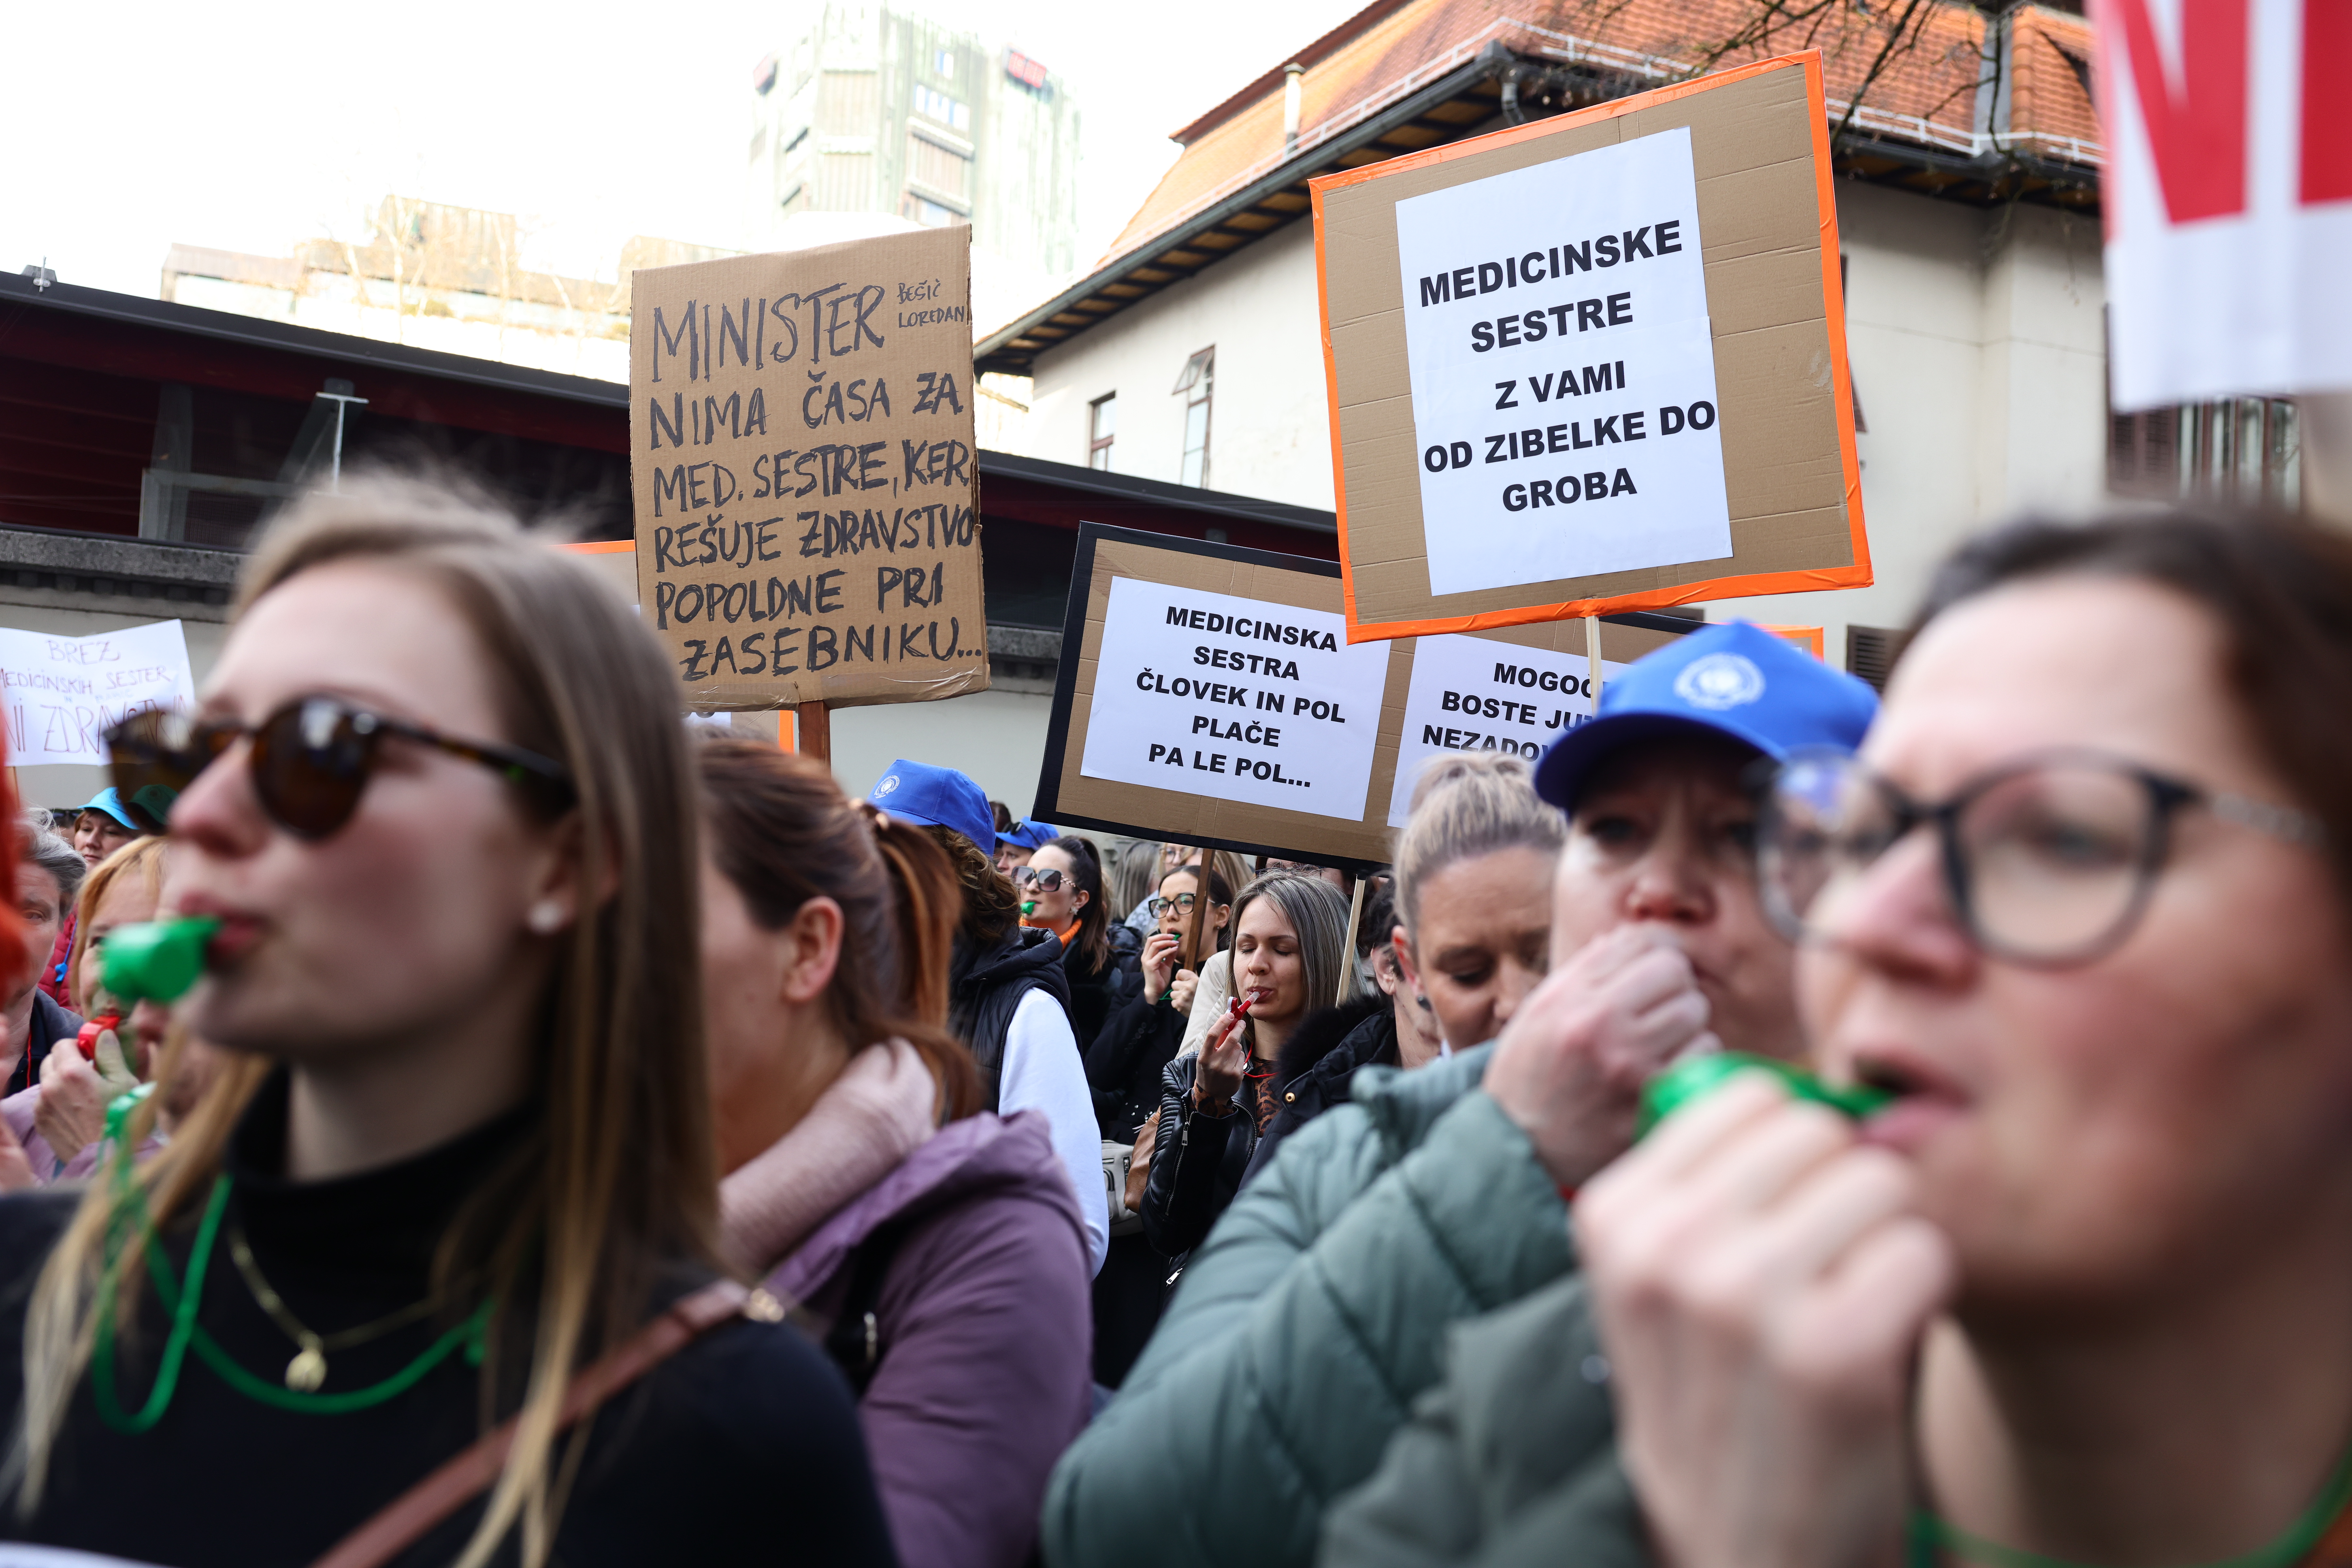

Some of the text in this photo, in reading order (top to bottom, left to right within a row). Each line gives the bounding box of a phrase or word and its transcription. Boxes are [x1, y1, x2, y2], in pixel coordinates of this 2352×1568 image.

[1420, 220, 1682, 307] MEDICINSKE
[652, 282, 885, 384] MINISTER
[899, 305, 965, 329] LOREDAN
[1471, 291, 1633, 353] SESTRE
[1495, 360, 1626, 410] Z VAMI
[650, 387, 771, 451] NIMA
[802, 370, 891, 429] ČASA
[1424, 401, 1715, 473] OD ZIBELKE DO
[654, 439, 970, 517] MED. SESTRE, KER
[1502, 468, 1638, 512] GROBA
[654, 503, 973, 573] REŠUJE ZDRAVSTVO
[656, 562, 943, 630] POPOLDNE PRI
[46, 639, 121, 665] BREZ
[679, 616, 982, 682] ZASEBNIKU...
[1165, 606, 1338, 652] MEDICINSKA
[106, 665, 173, 690] SESTER
[1193, 646, 1300, 681] SESTRA
[1493, 663, 1613, 699] MOGOČ
[1136, 667, 1346, 724] ČLOVEK IN POL
[1442, 691, 1594, 732] BOSTE JU
[1192, 716, 1281, 748] PLAČE
[1422, 725, 1549, 763] NEZADO
[1148, 744, 1311, 788] PA LE POL...
